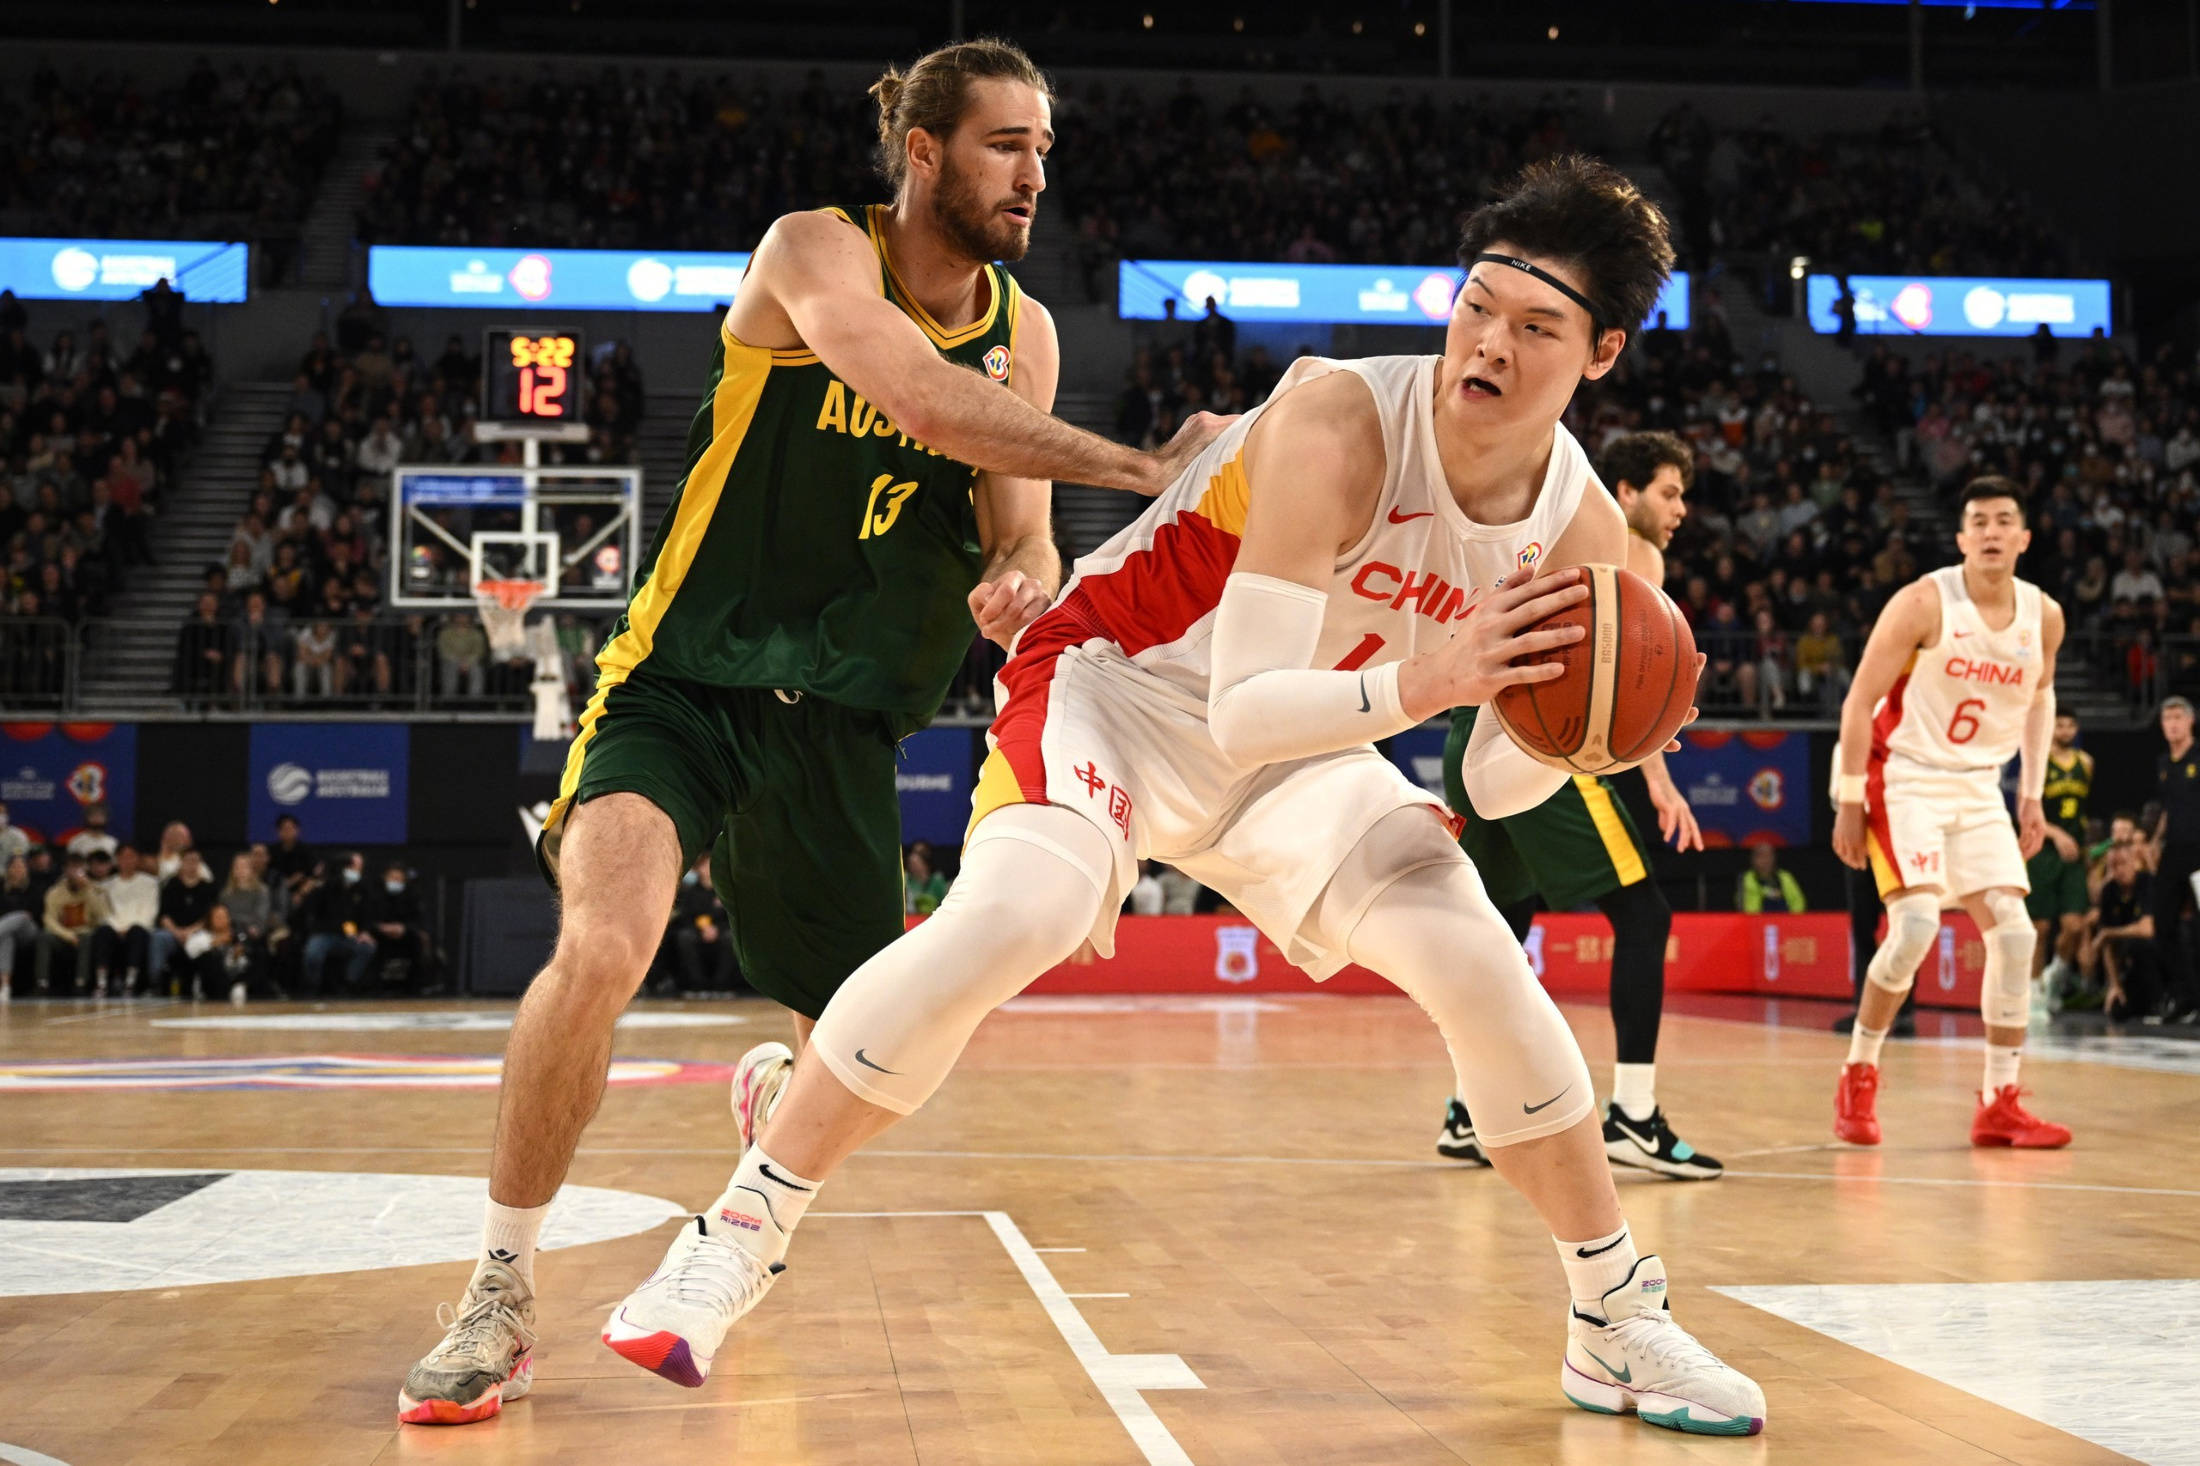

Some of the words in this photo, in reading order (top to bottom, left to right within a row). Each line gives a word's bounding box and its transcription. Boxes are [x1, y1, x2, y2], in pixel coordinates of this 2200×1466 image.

[1511, 259, 1532, 272] NIKE
[510, 336, 575, 368] 5:22
[519, 367, 567, 416] 12
[858, 473, 919, 540] 13
[1350, 560, 1481, 624] CHIN
[1945, 657, 2023, 686] CHINA
[1947, 698, 1986, 745] 6
